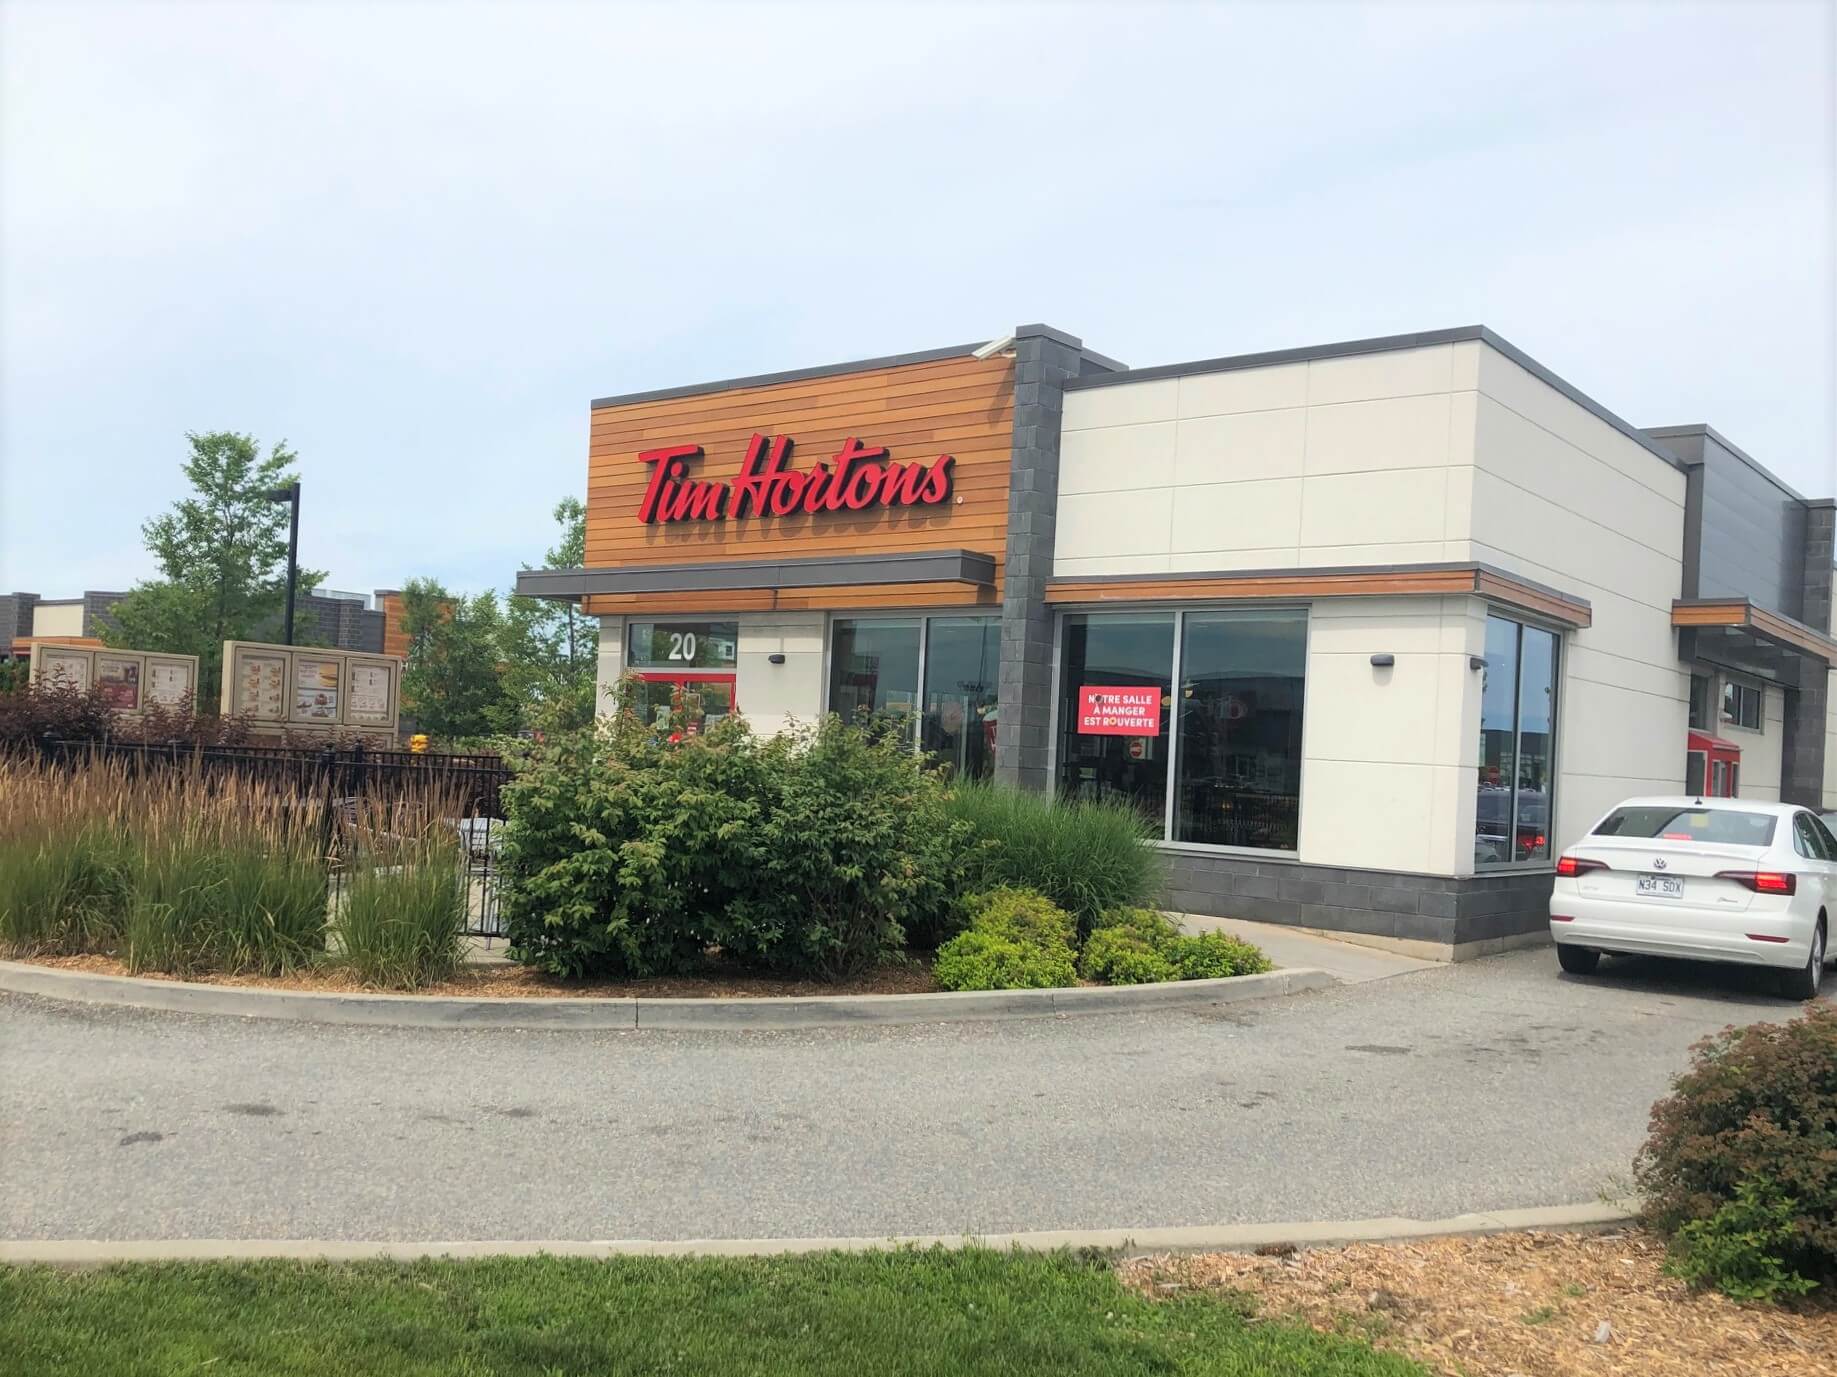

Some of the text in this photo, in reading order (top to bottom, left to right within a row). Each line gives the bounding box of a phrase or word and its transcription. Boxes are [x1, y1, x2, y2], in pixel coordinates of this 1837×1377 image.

[638, 433, 955, 524] Tim Hortons
[668, 632, 696, 661] 20
[1122, 695, 1152, 705] SALLE
[1102, 706, 1146, 716] MANGER
[1084, 716, 1155, 728] EST ROUVERTE
[1639, 879, 1657, 891] N34
